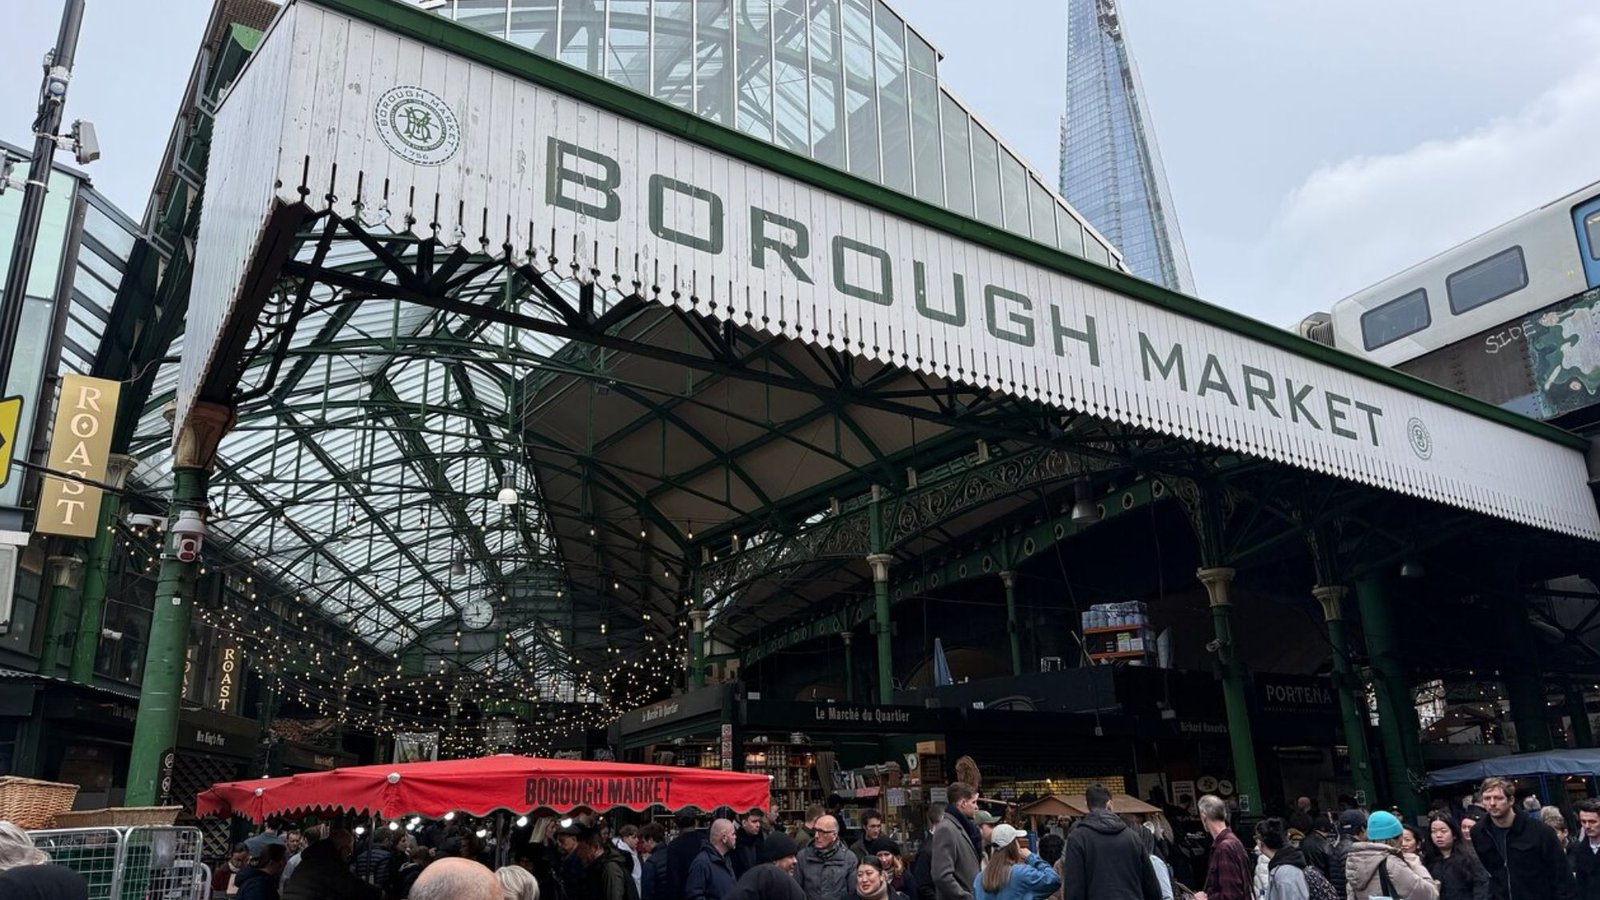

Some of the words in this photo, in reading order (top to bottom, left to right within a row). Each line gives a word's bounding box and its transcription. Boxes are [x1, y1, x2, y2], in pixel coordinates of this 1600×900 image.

[380, 90, 424, 127] BOROUGH
[430, 99, 455, 148] MARKET
[403, 147, 430, 160] 1756
[545, 136, 1100, 367] BOROUGH
[1138, 331, 1383, 446] MARKET
[1485, 320, 1537, 354] SIDE
[56, 386, 101, 525] ROAST
[218, 648, 235, 711] ROAST
[1265, 683, 1333, 705] PORTEÑA
[815, 706, 825, 720] Le
[828, 706, 860, 721] Marché
[862, 708, 873, 721] du
[875, 708, 910, 724] Quartier
[525, 777, 604, 806] BOROUGH
[608, 777, 673, 803] MARKET
